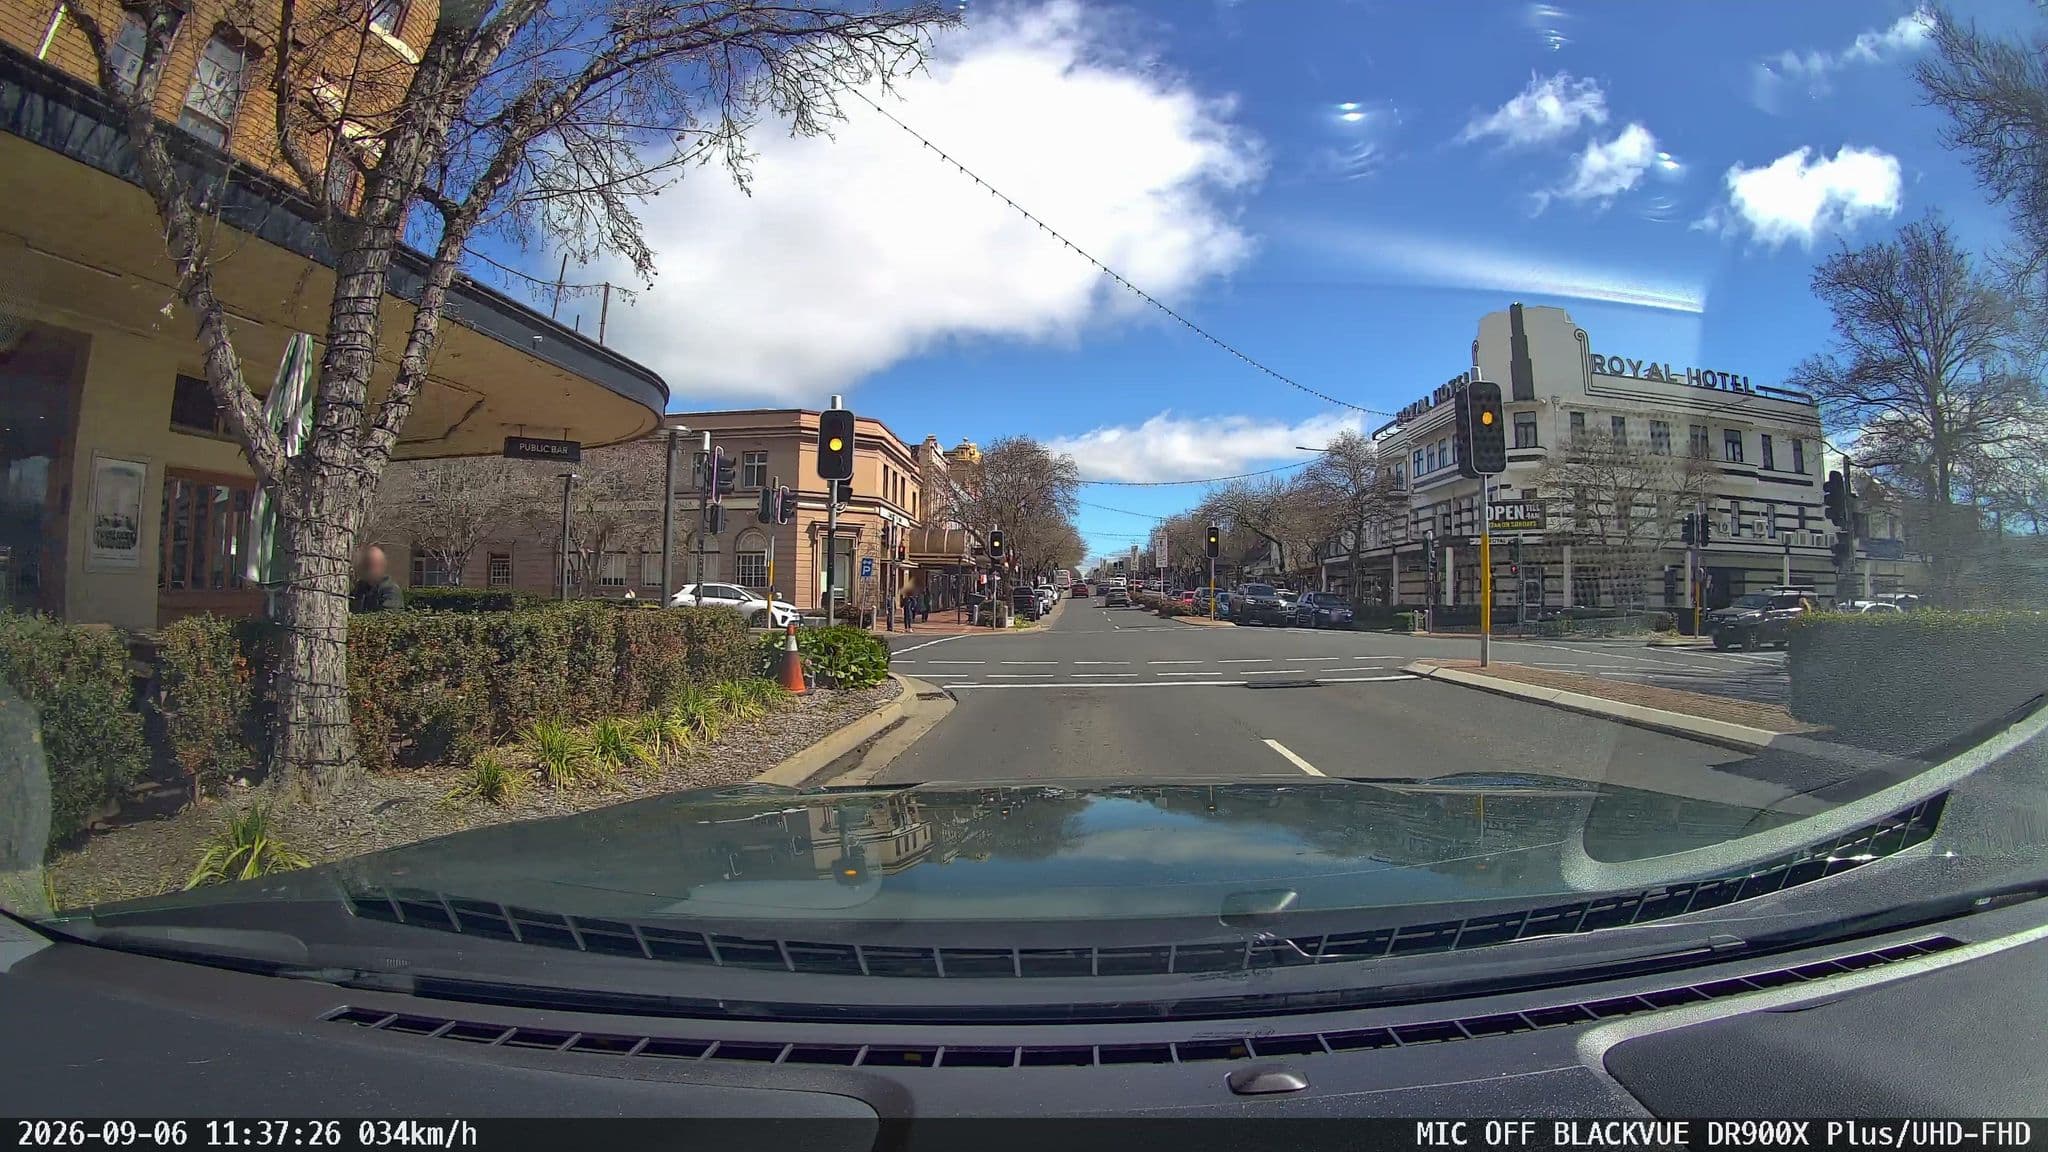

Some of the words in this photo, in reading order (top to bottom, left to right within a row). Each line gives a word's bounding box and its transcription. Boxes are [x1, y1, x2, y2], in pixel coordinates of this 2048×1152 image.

[1590, 353, 1677, 384] ROYAL
[1686, 366, 1755, 394] HOTEL
[519, 443, 549, 453] PUBLIC
[551, 446, 568, 454] BAR
[1486, 505, 1525, 520] OPEN
[862, 566, 871, 575] P
